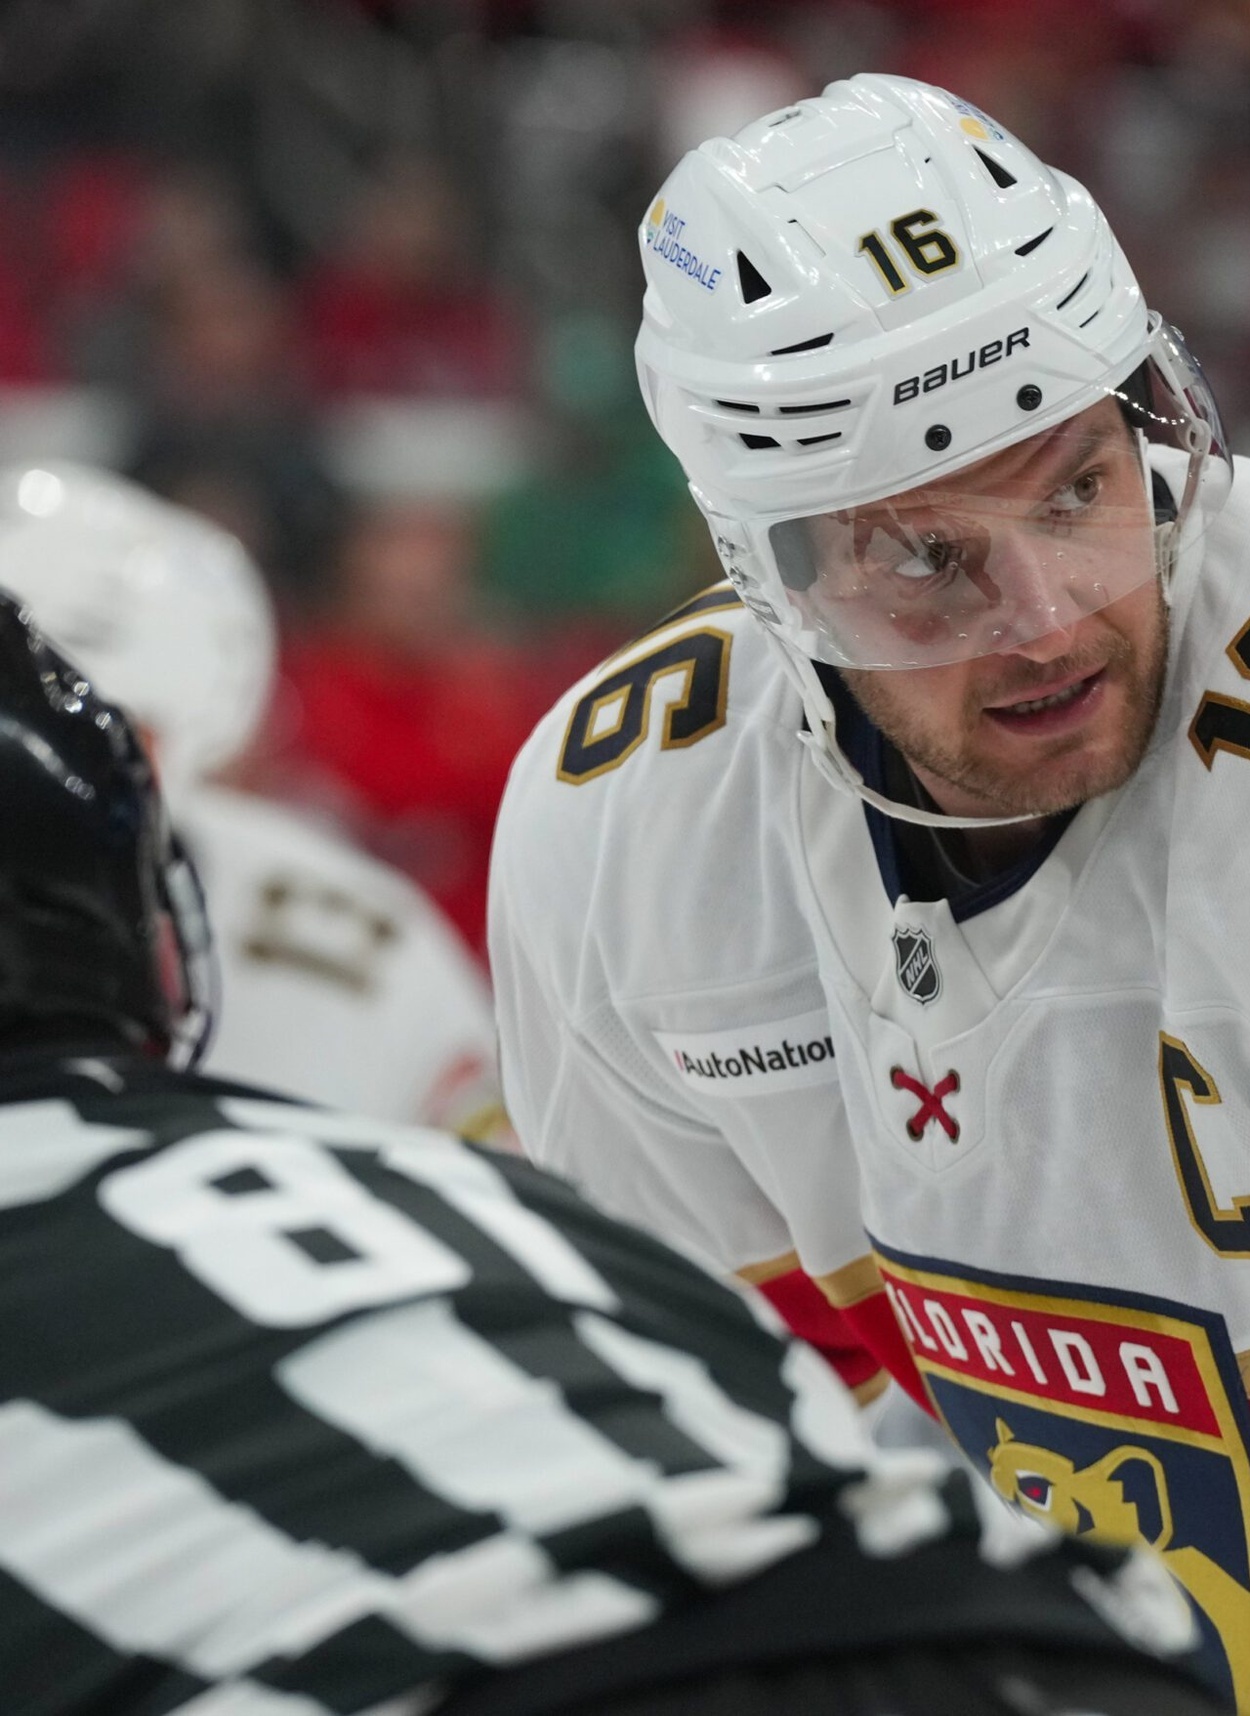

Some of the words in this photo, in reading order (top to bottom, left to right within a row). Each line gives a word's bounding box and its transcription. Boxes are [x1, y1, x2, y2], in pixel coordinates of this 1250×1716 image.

[663, 210, 686, 241] VISIT
[858, 208, 963, 295] 16
[653, 231, 721, 290] LAUDERDALE
[905, 946, 928, 989] NHL
[98, 1130, 625, 1329] 81
